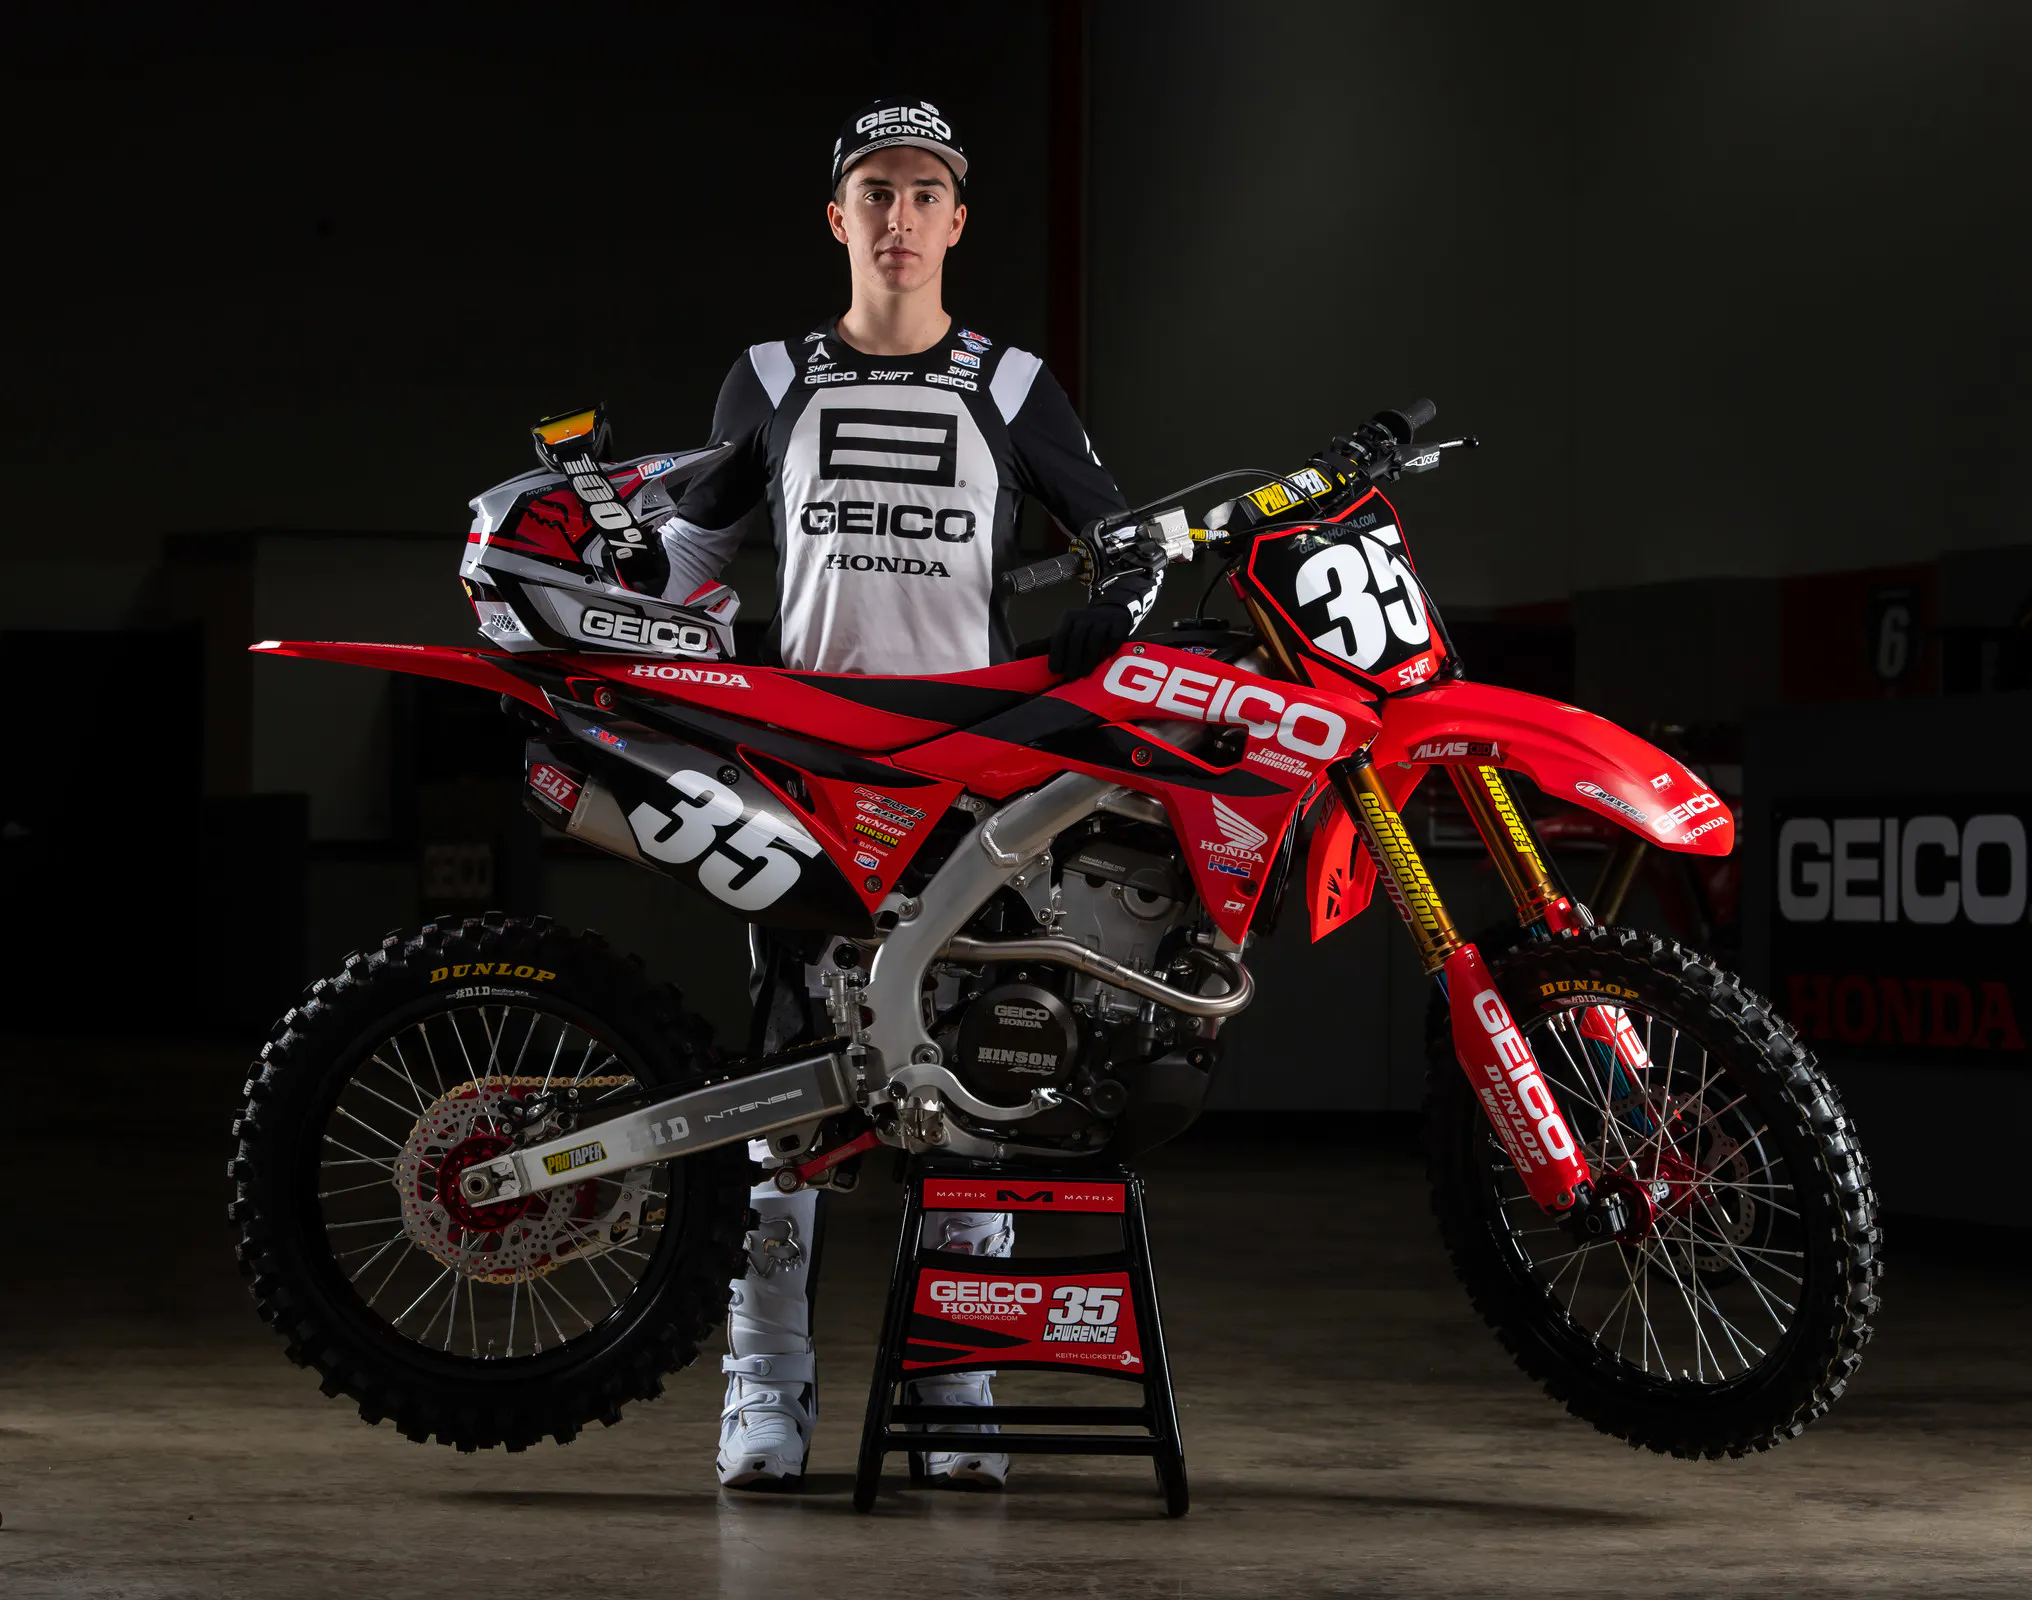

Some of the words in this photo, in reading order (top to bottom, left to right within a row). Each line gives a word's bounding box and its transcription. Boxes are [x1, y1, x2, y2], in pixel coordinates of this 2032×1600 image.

[856, 107, 951, 140] GEICO
[957, 329, 993, 346] AMA
[806, 362, 838, 374] SHIFT
[954, 352, 978, 366] 100%
[804, 371, 858, 385] GEICO
[867, 370, 914, 382] SHIFT
[925, 373, 978, 392] GEICO
[947, 366, 979, 380] SHIFT
[642, 458, 671, 475] 100%
[562, 453, 648, 560] 100%
[800, 501, 976, 544] GEICO
[826, 554, 951, 578] HONDA
[1295, 524, 1430, 671] 35
[582, 609, 709, 651] GEICO
[631, 665, 752, 689] HONDA
[1398, 657, 1432, 686] SHIFT
[1102, 655, 1347, 760] GEICO
[583, 726, 628, 753] AMA
[1259, 747, 1308, 769] Factory
[533, 766, 573, 801] ヨシムラ
[855, 813, 907, 837] DUNLOP
[1651, 793, 1721, 835] GEICO
[627, 769, 824, 911] 35
[855, 822, 899, 846] HINSON
[1680, 816, 1729, 844] HONDA
[857, 854, 876, 868] 100%
[1200, 839, 1265, 864] HONDA
[1384, 810, 1443, 908] Factory
[1207, 853, 1253, 879] HRC
[1777, 814, 2029, 925] GEICO
[430, 962, 557, 984] DUNLOP
[1540, 979, 1640, 1000] DUNLOP
[994, 1004, 1050, 1021] GEICO
[998, 1017, 1043, 1029] HONDA
[1784, 971, 2028, 1052] HONDA
[977, 1046, 1058, 1067] HINSON
[1473, 988, 1579, 1168] GEICO
[704, 1088, 803, 1123] INTENSE
[1483, 1063, 1548, 1167] DUNLOP
[1478, 1087, 1534, 1174] WISECO
[547, 1143, 604, 1176] PROTAPER
[936, 1190, 987, 1199] MATRIX
[1064, 1194, 1115, 1202] MATRIX
[930, 1280, 1043, 1304] GEICO
[940, 1302, 1028, 1316] HONDA
[951, 1313, 1019, 1322] GEICOHONDA.COM
[1047, 1286, 1124, 1326] 35
[1042, 1324, 1118, 1344] LAWRENCE
[1055, 1352, 1079, 1360] KEITH
[1079, 1352, 1125, 1361] CLICKSTEIN
